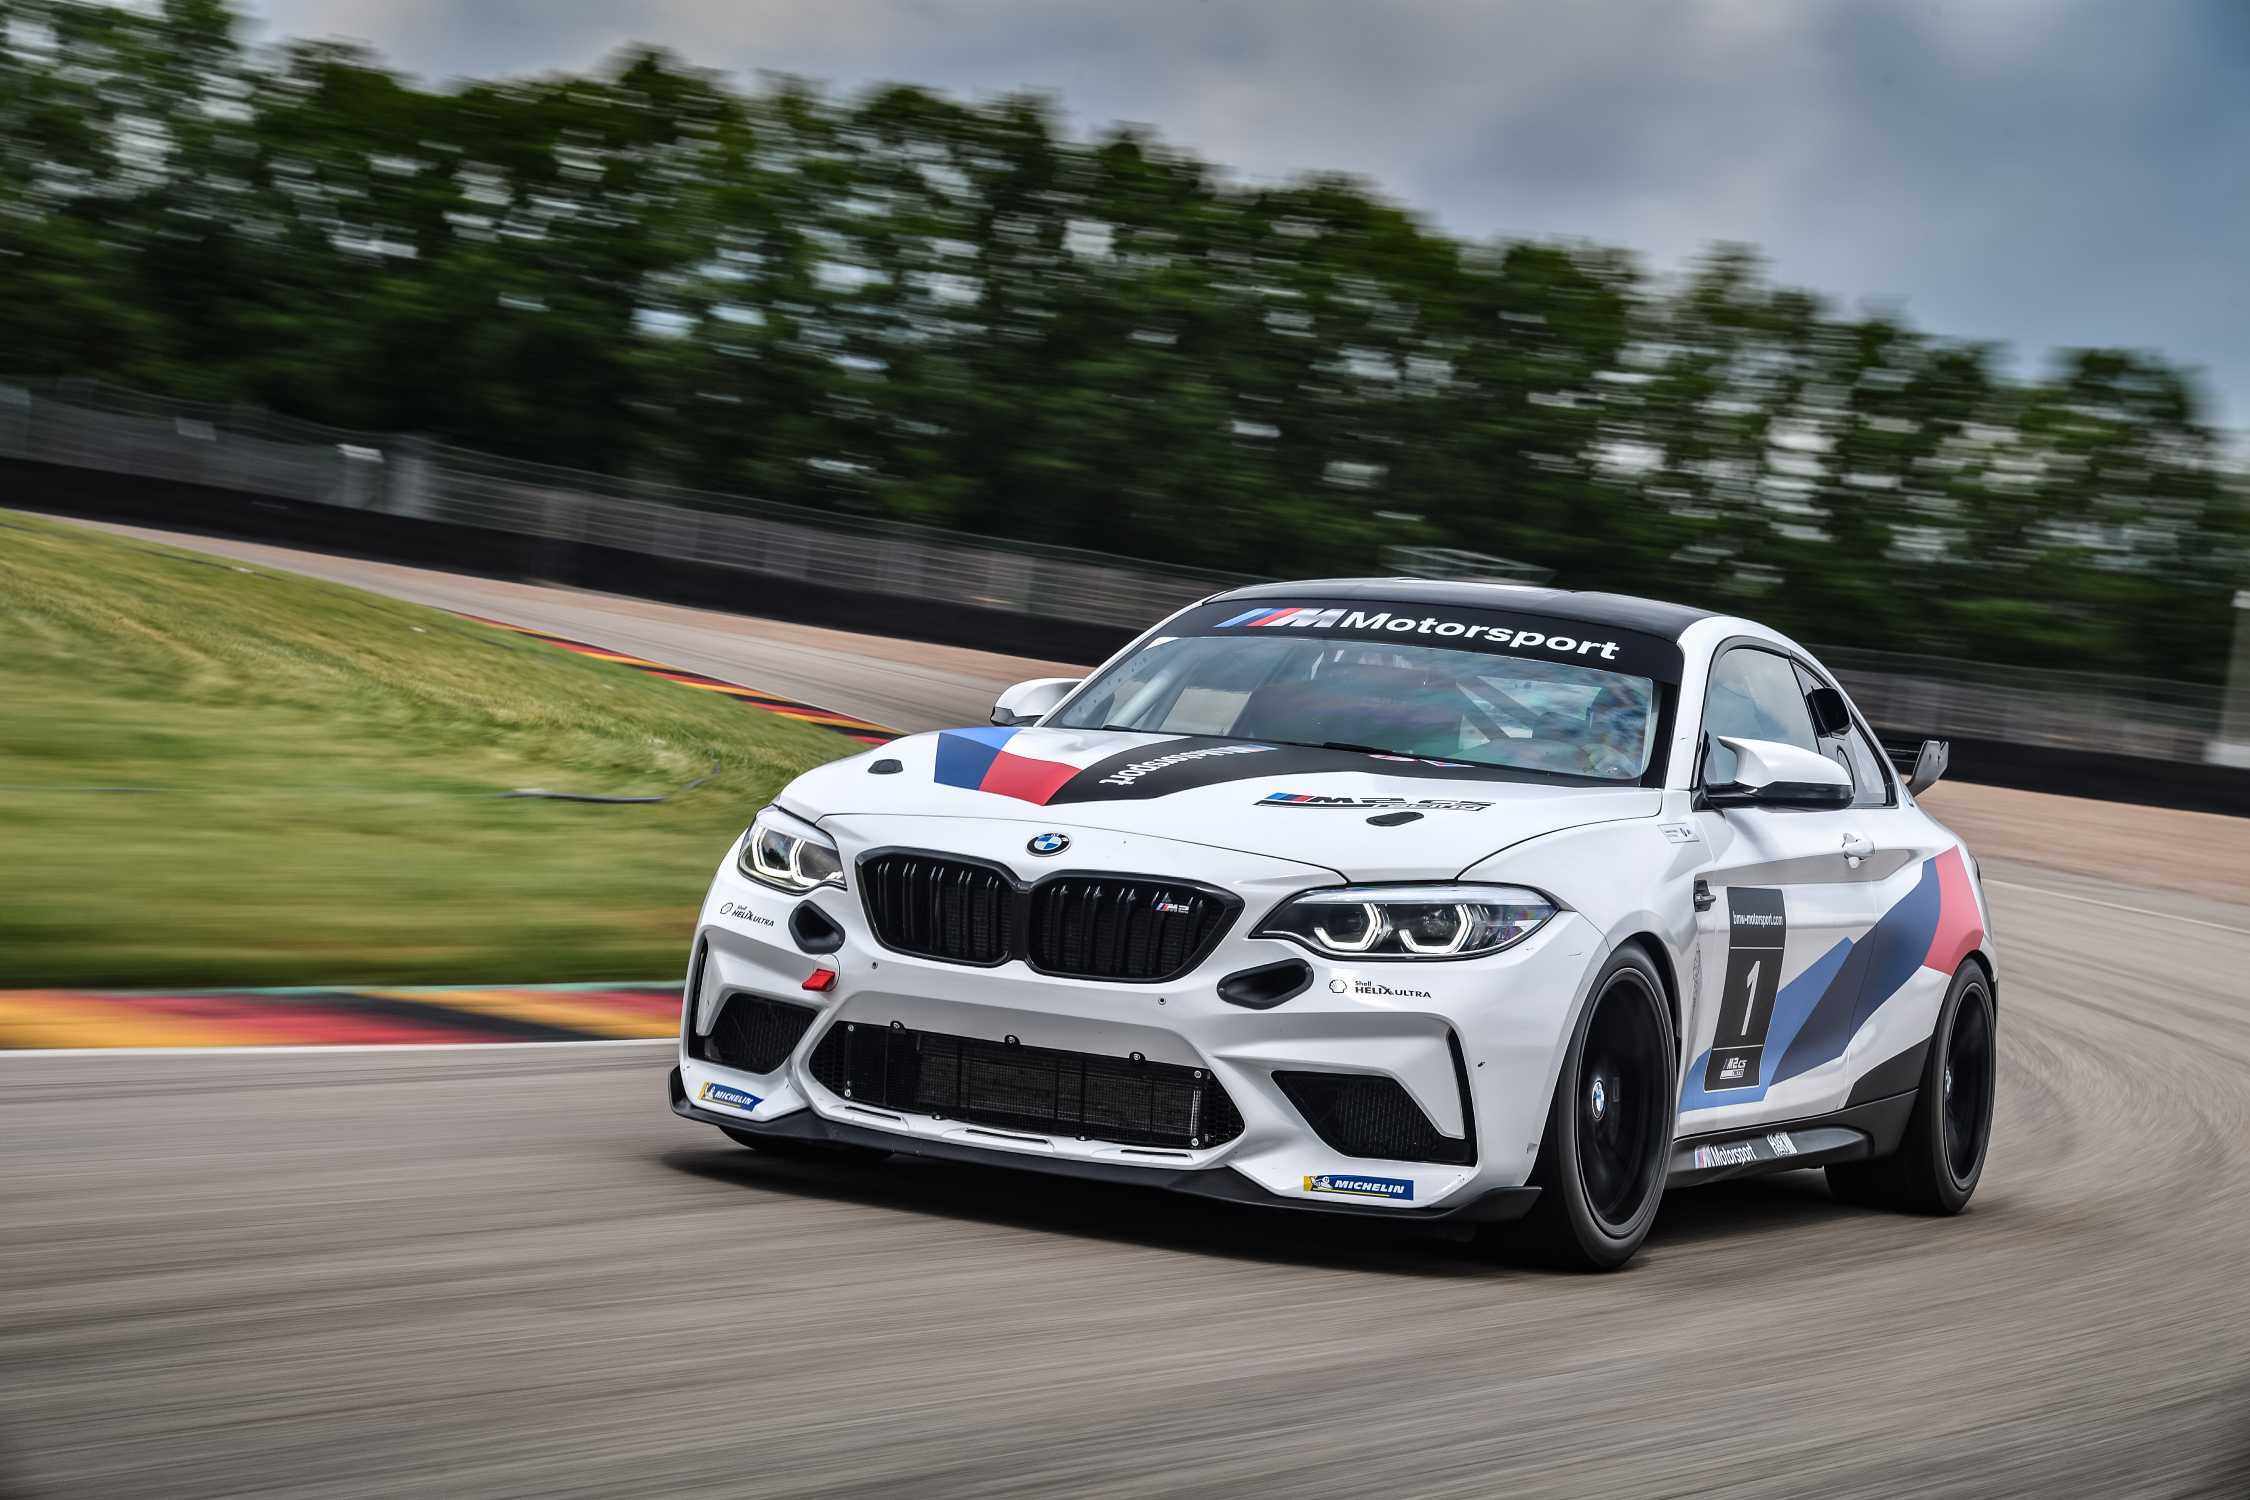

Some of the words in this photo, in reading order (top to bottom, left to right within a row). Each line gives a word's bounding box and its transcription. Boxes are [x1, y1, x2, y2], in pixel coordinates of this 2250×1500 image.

[1338, 611, 1621, 661] Motorsport
[1354, 985, 1392, 996] HELIX
[1394, 989, 1432, 999] ULTRA
[1740, 960, 1761, 1036] 1
[715, 1091, 754, 1105] MICHELIN
[1334, 1180, 1405, 1193] MICHELIN
